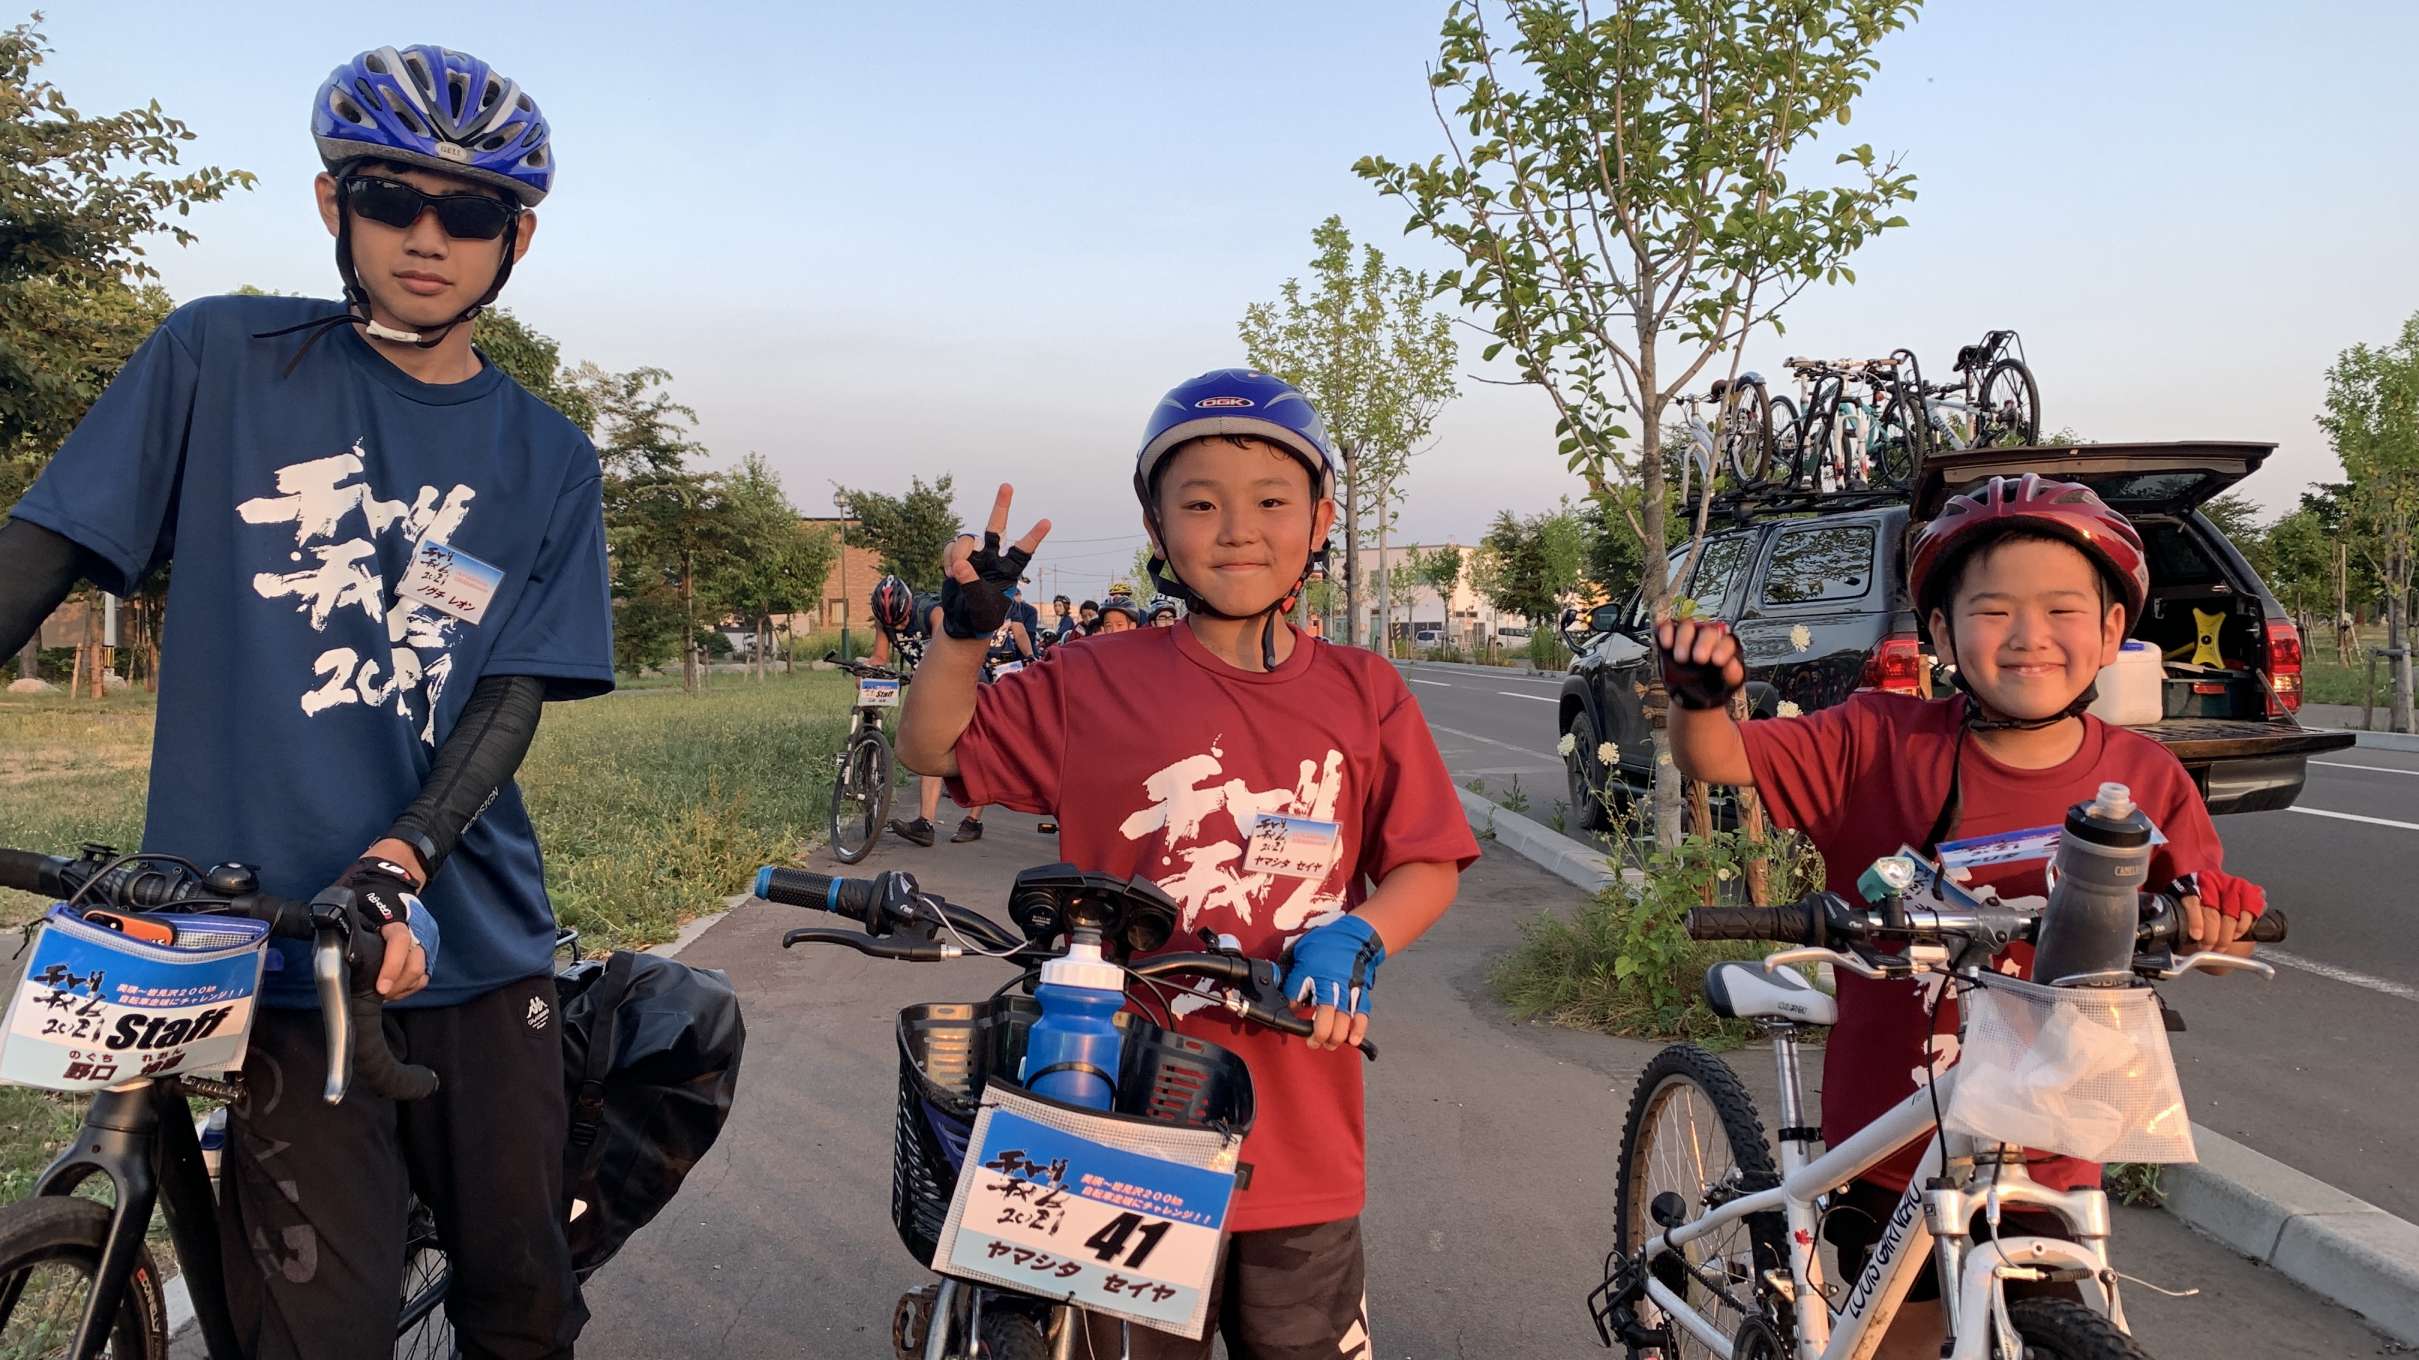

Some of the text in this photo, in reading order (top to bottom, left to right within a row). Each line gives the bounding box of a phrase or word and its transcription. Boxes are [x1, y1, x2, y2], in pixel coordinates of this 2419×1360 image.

[417, 585, 476, 611] ノグチ レオン
[875, 690, 894, 698] Staff
[1254, 855, 1322, 872] ヤマシタ セイヤ
[105, 1005, 233, 1050] Staff
[69, 1048, 182, 1063] のぐち れおん
[63, 1062, 118, 1081] 野口
[1084, 1211, 1174, 1269] 41
[986, 1240, 1176, 1303] ヤマシタ セイヤ
[1849, 1264, 1880, 1319] LOUIS
